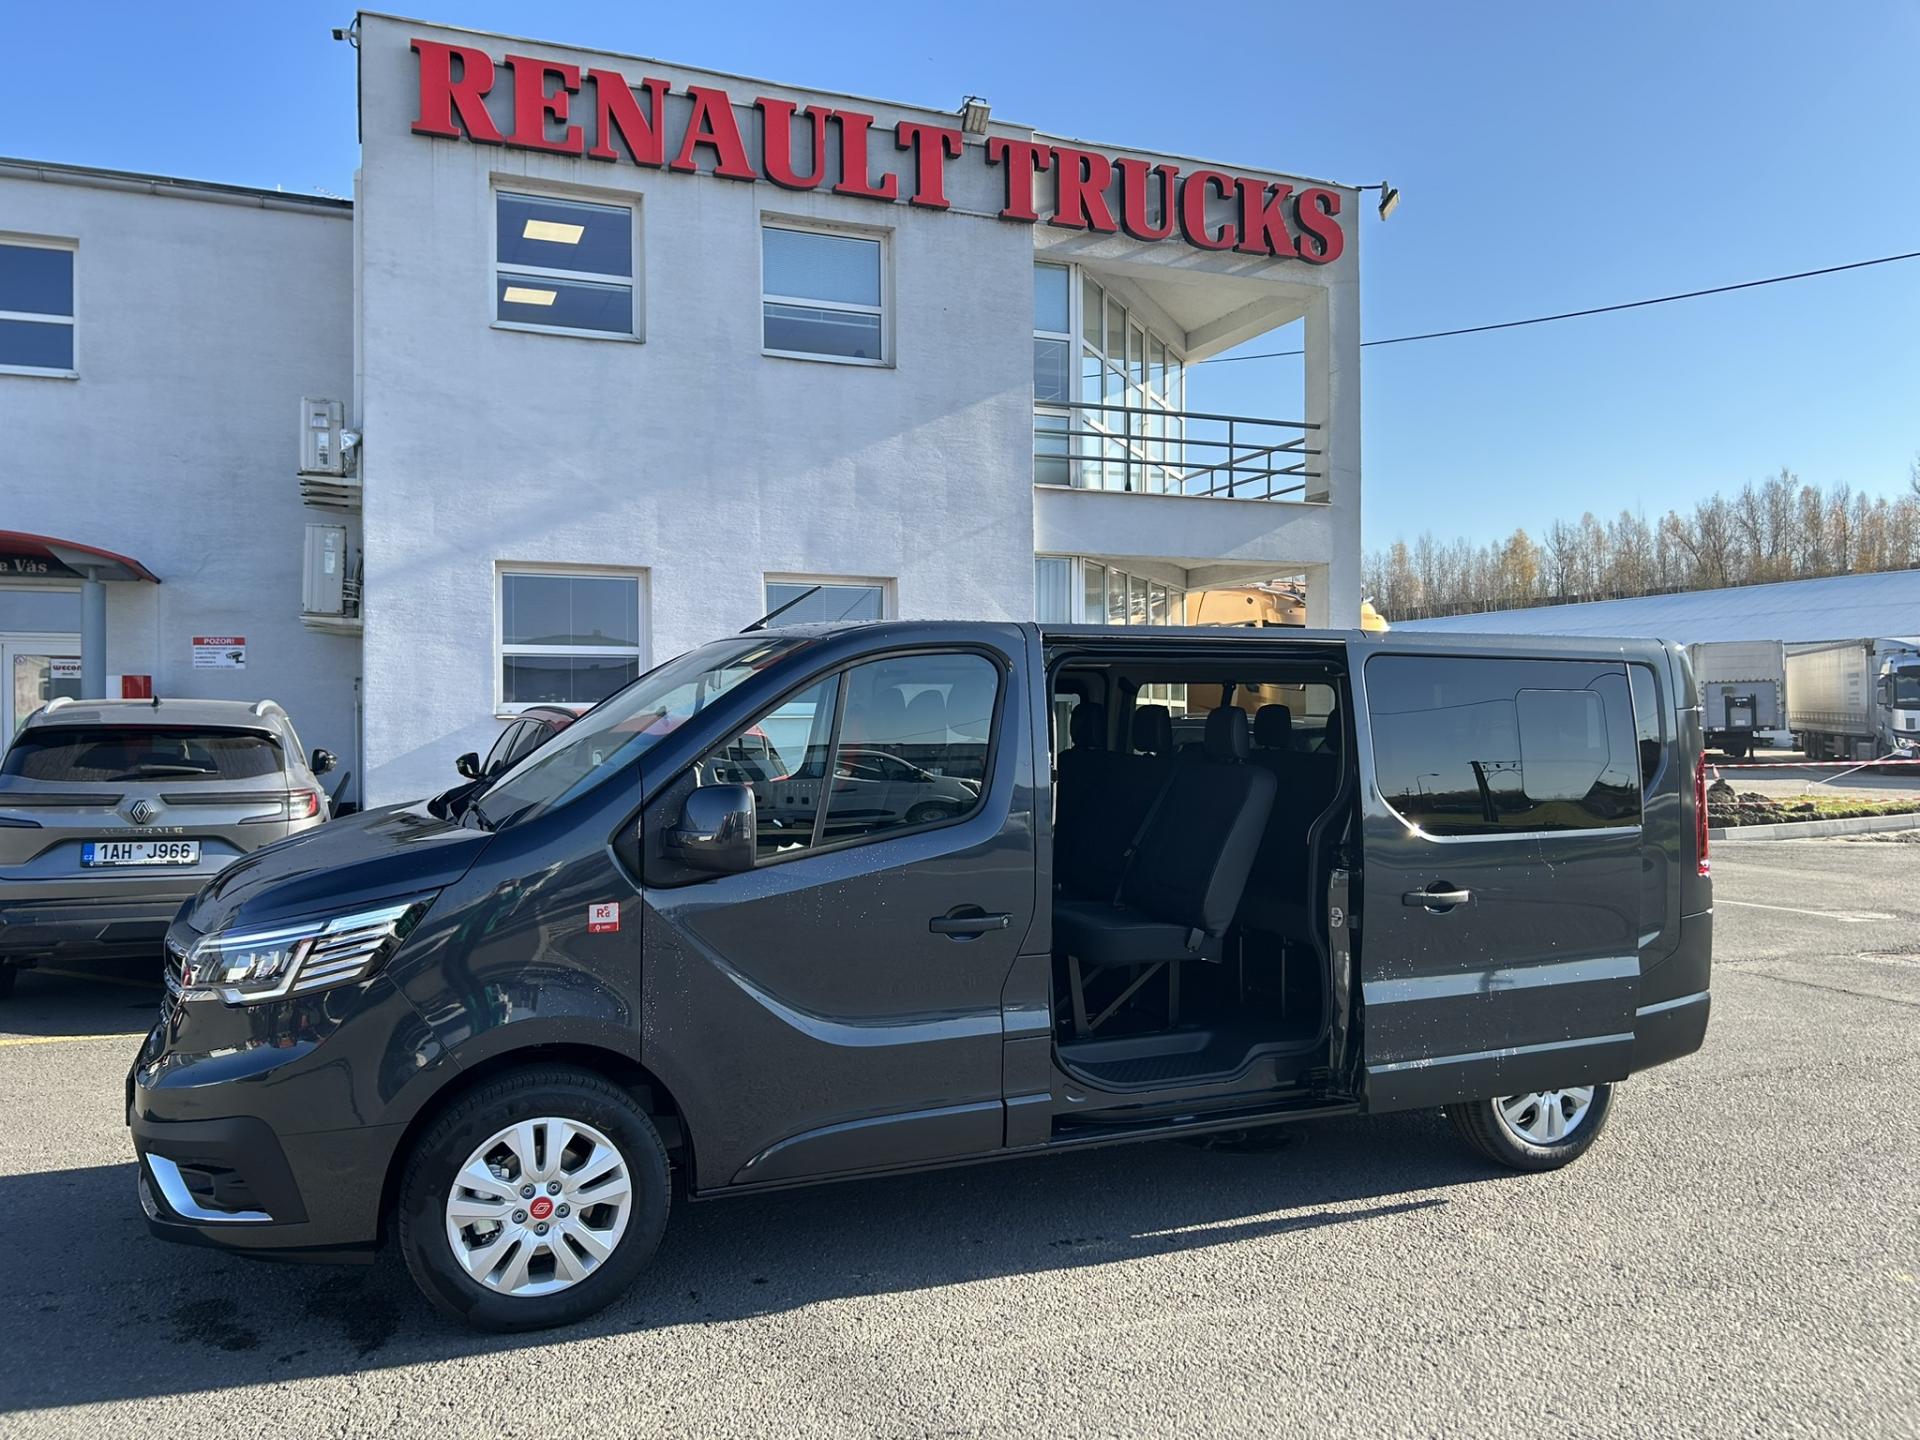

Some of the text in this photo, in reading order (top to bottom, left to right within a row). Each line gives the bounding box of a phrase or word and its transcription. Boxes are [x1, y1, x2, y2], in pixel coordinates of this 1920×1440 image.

[410, 38, 1344, 265] RENAULT TRUCKS
[14, 559, 48, 573] Vás
[100, 844, 132, 860] 1AH
[147, 843, 191, 859] J966
